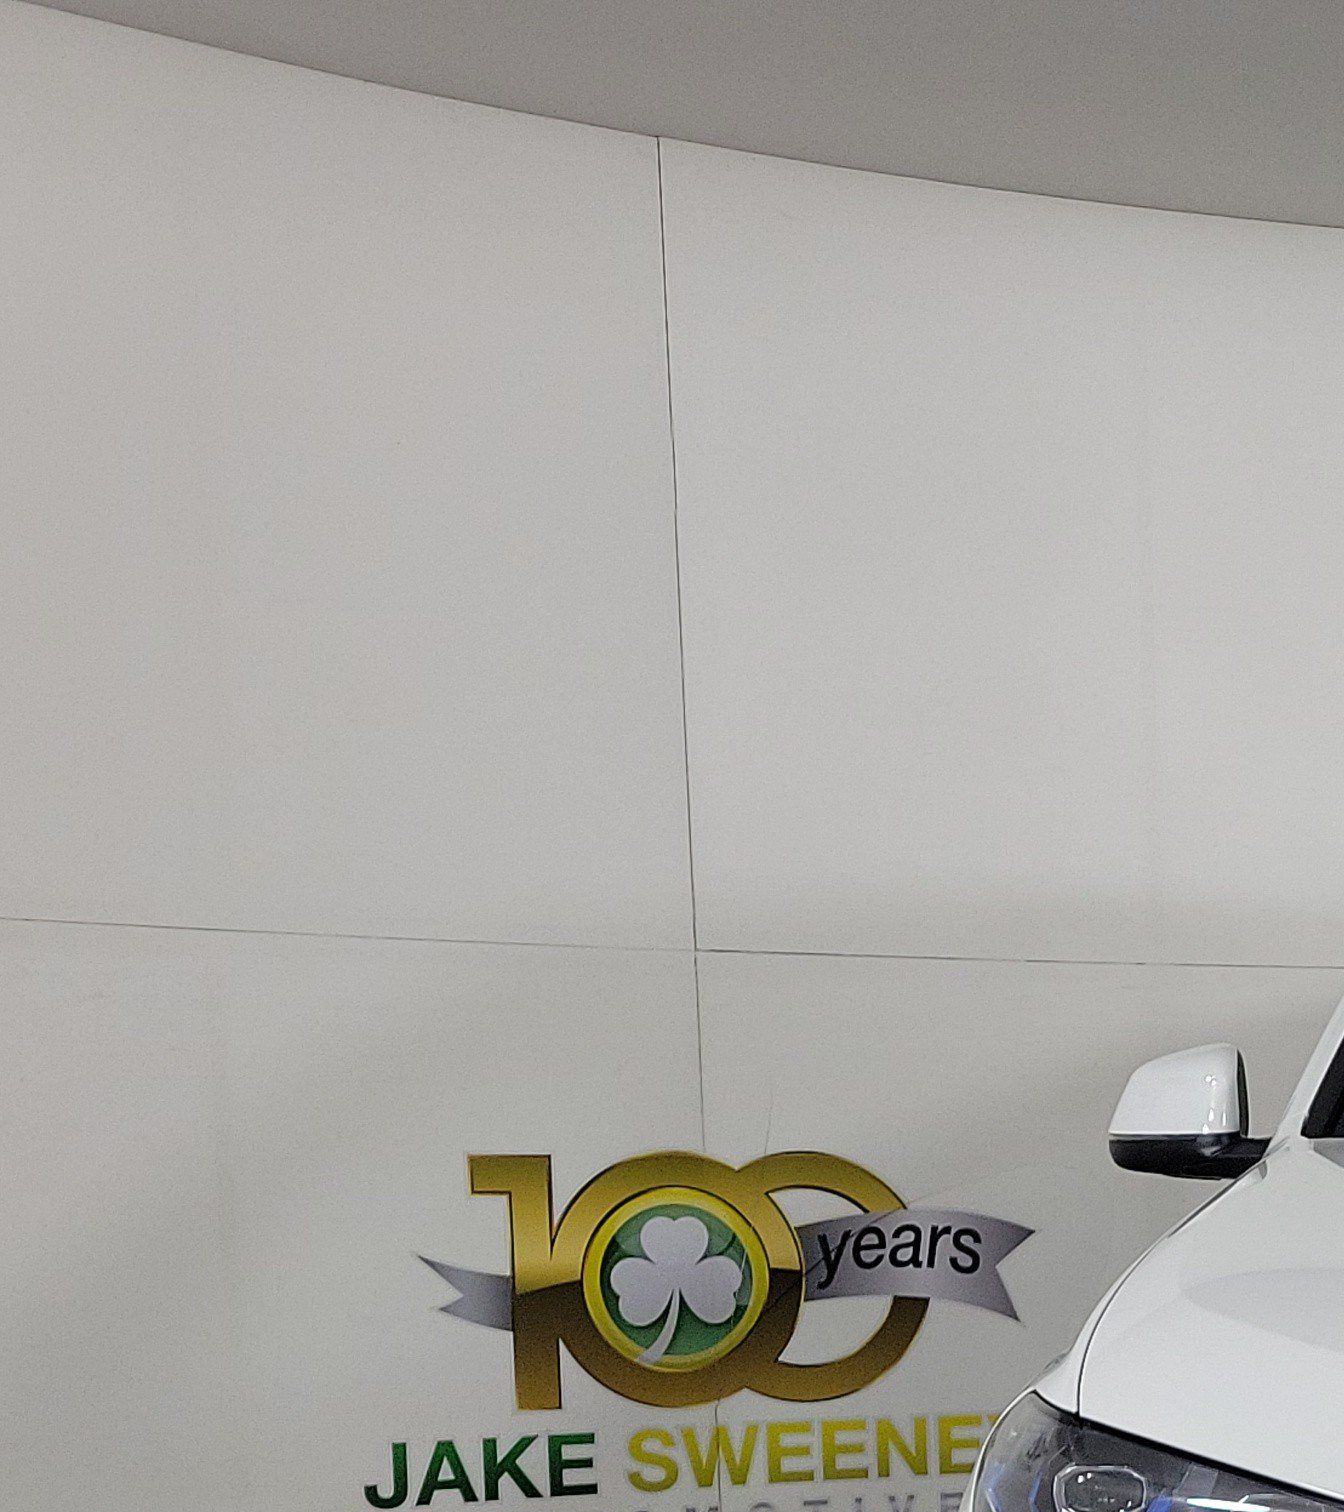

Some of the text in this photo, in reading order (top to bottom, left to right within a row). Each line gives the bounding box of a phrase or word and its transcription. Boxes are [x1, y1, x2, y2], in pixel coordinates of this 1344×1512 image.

[467, 1150, 931, 1411] 100
[816, 1222, 983, 1290] years
[363, 1412, 1000, 1509] JAKE SWEENE
